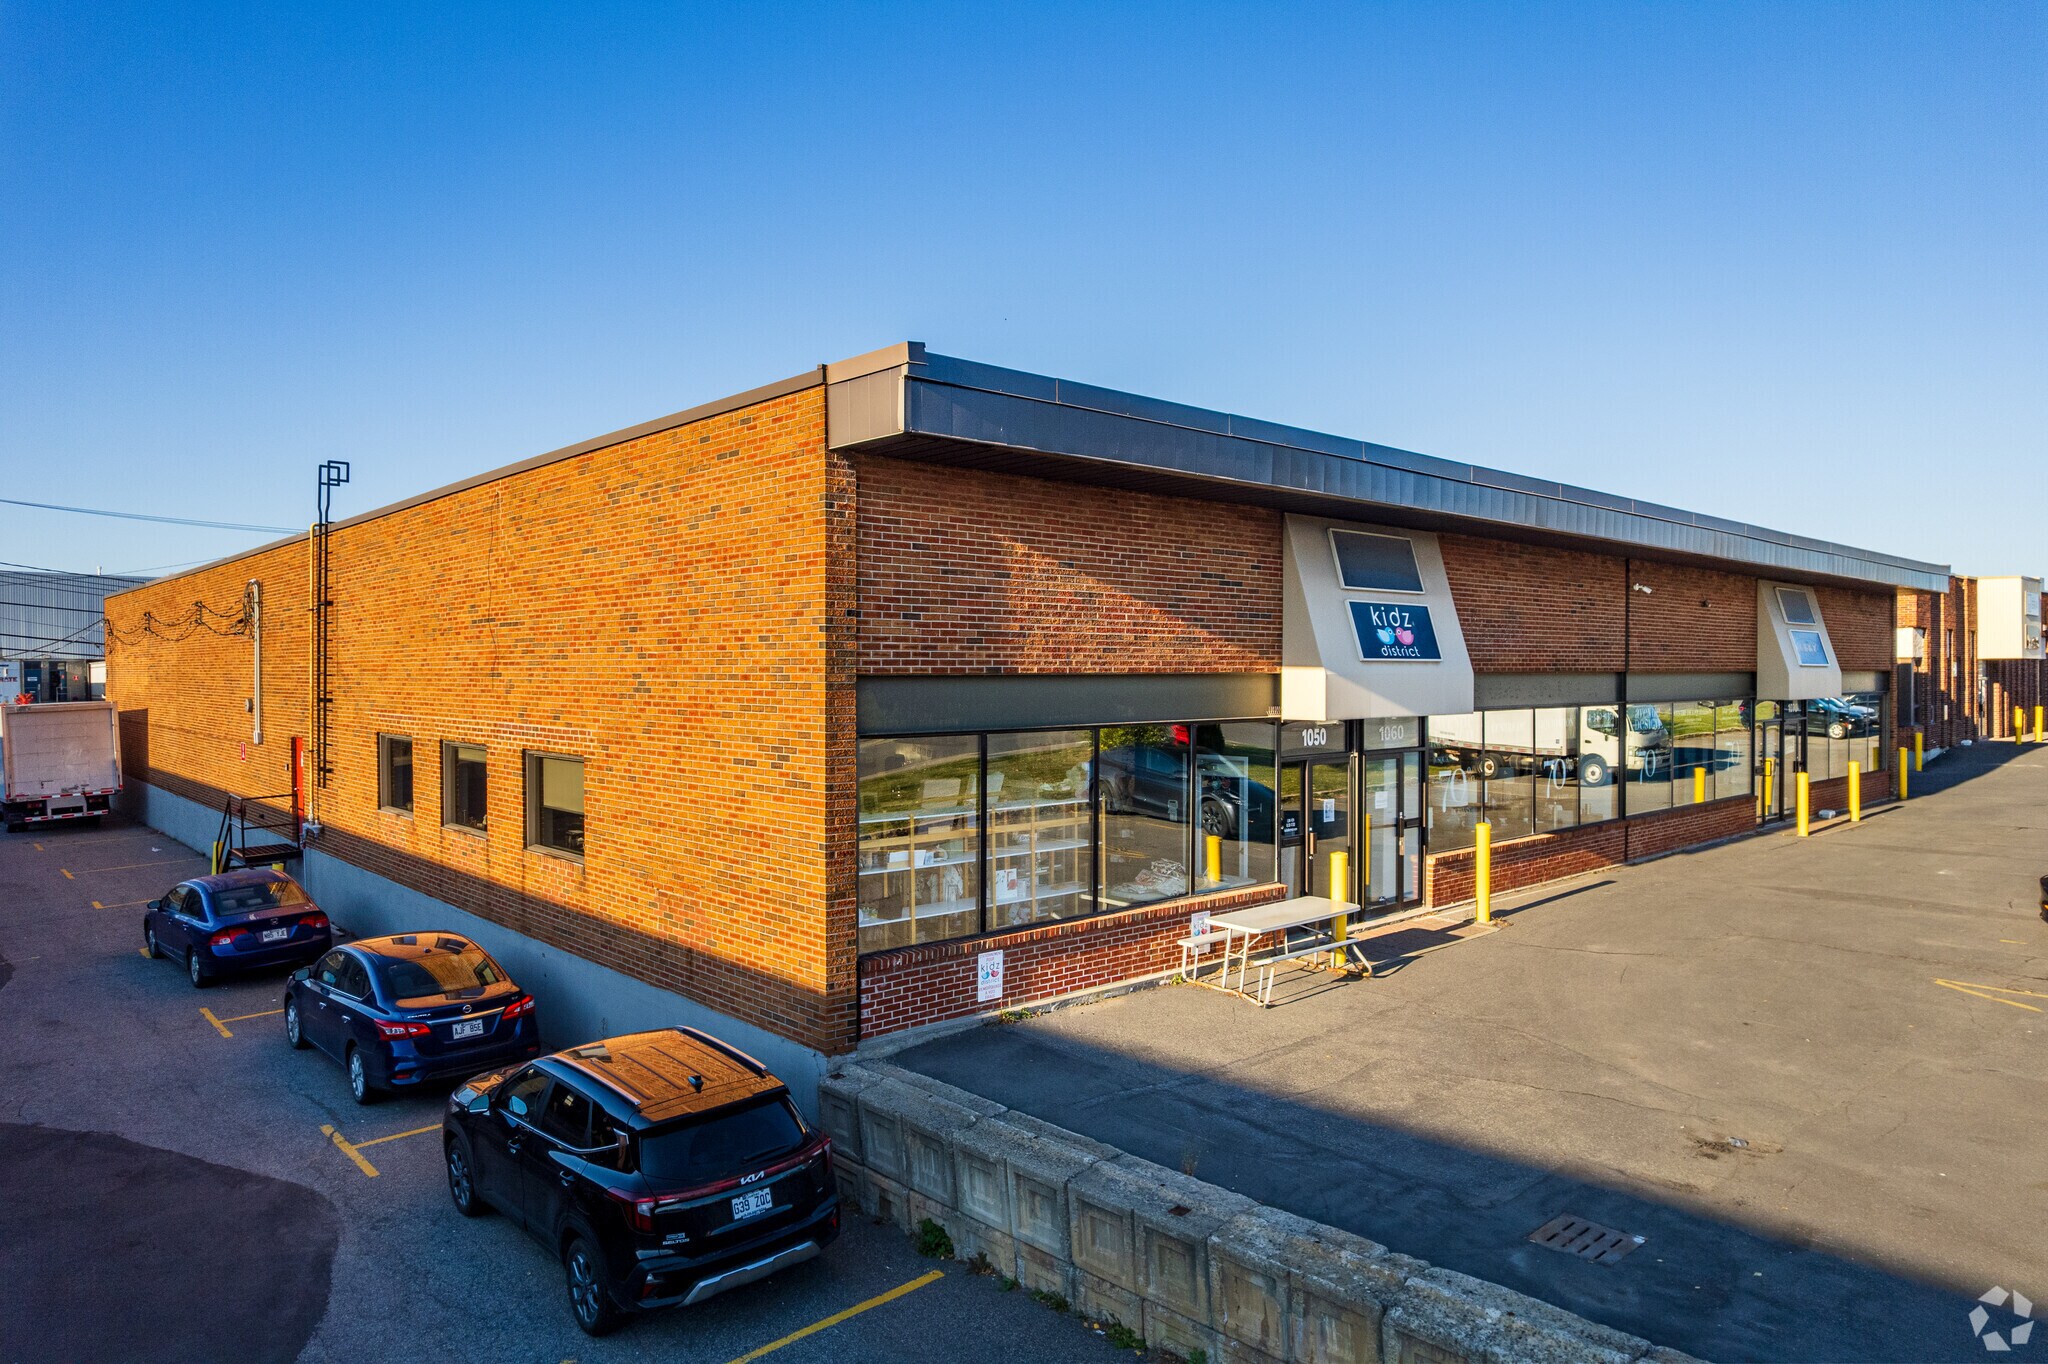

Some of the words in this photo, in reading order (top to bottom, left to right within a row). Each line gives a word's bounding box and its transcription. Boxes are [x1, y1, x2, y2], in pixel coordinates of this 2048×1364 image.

[1370, 606, 1412, 627] kidz
[1381, 646, 1421, 657] district
[1302, 728, 1327, 747] 1050
[1379, 725, 1404, 741] 1060
[981, 962, 1000, 972] kidz
[455, 1025, 466, 1036] AJF
[740, 1171, 765, 1185] KIA
[734, 1200, 750, 1215] G39
[755, 1193, 770, 1208] ZQC
